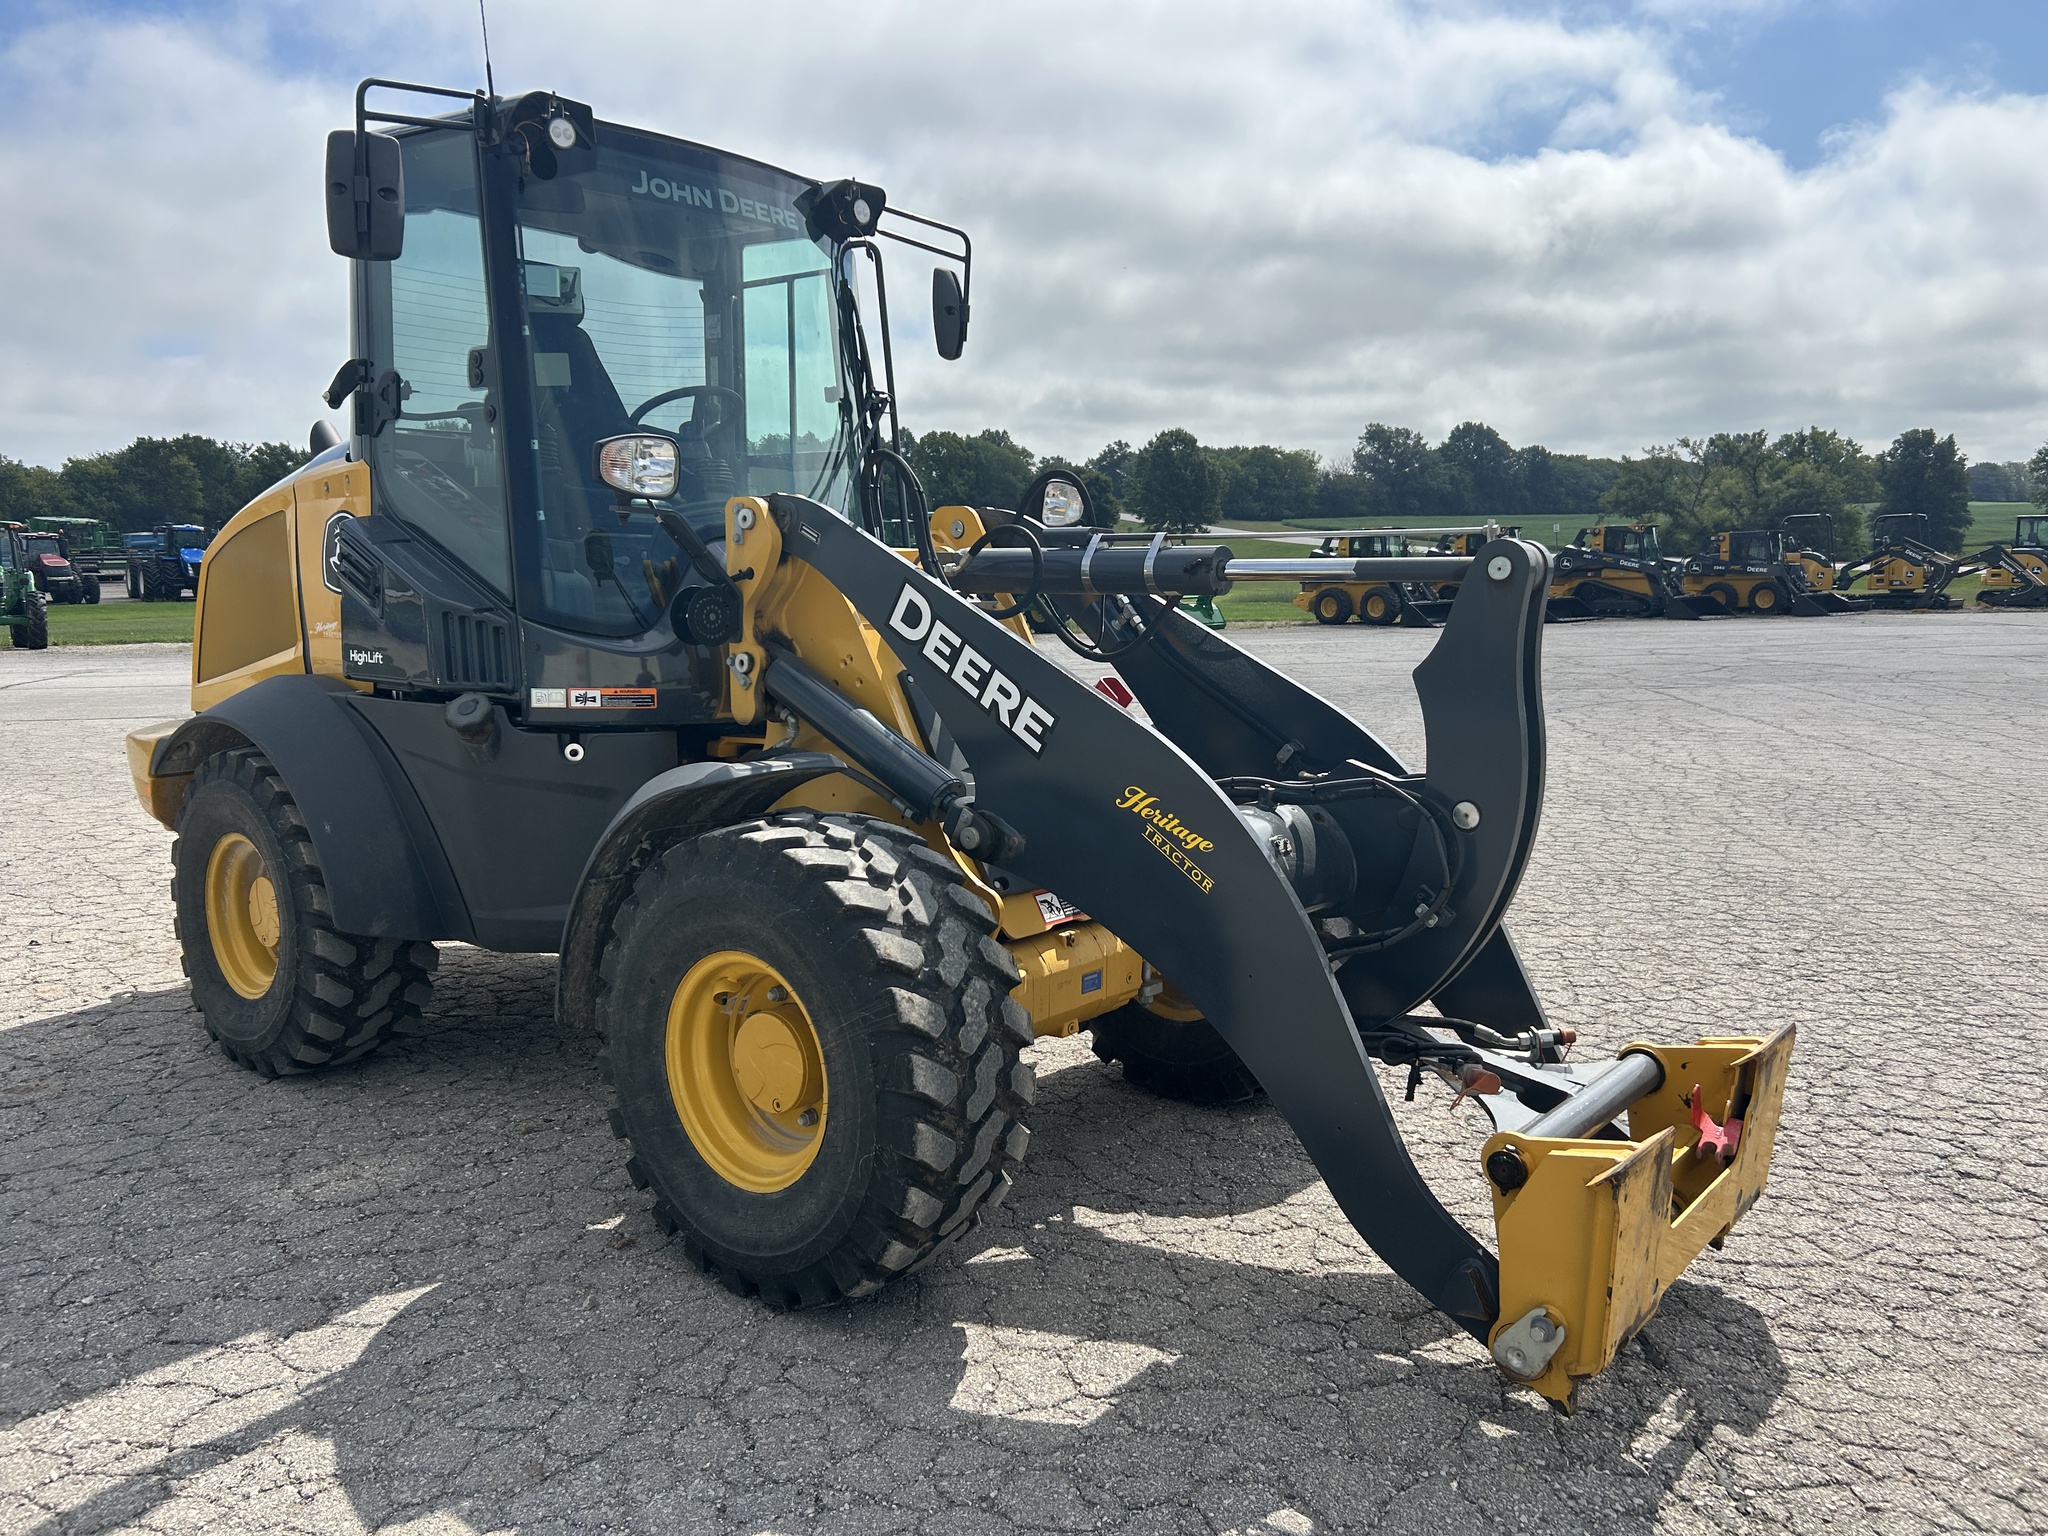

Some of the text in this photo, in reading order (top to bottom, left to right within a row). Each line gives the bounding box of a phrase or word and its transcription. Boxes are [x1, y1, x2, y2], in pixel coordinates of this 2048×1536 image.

[632, 170, 799, 231] JOHN DEERE
[1619, 559, 1640, 568] DEERE
[350, 649, 384, 665] HighLift
[888, 582, 1055, 753] DEERE
[1115, 785, 1215, 853] Heritage
[1144, 826, 1213, 892] TRACTOR
